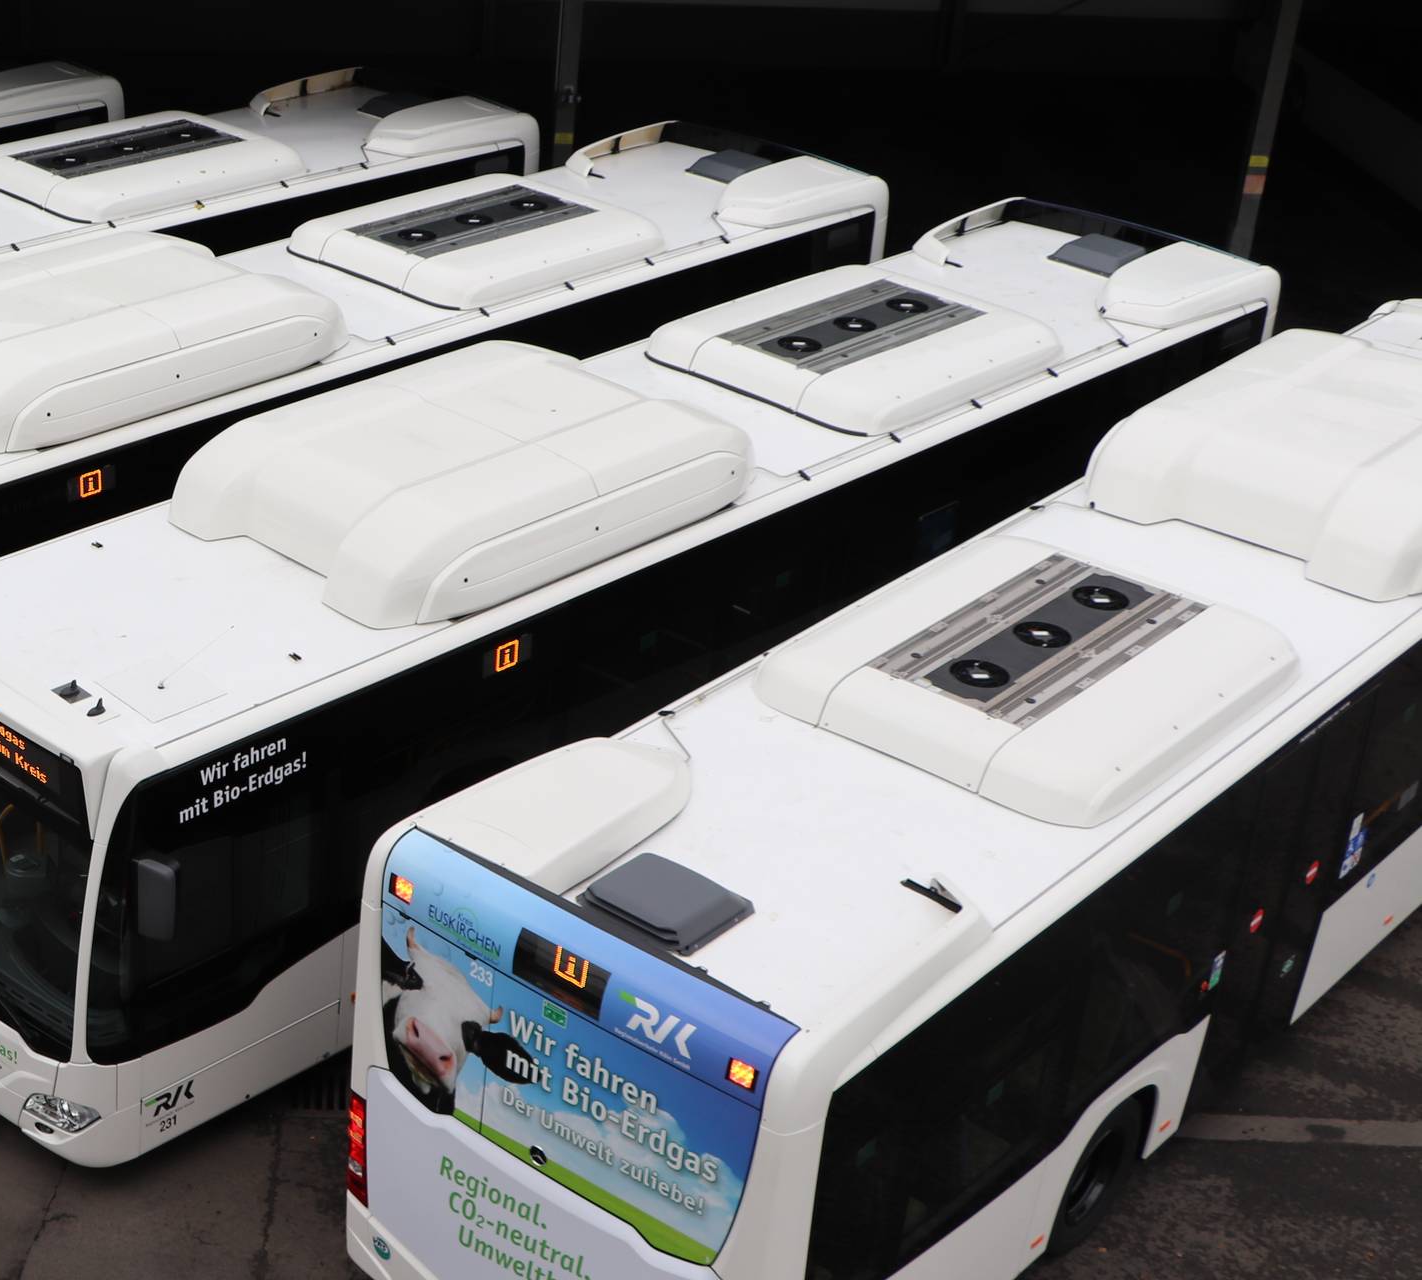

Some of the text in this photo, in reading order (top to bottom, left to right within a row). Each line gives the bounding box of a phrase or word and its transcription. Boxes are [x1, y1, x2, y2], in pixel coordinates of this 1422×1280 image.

[14, 752, 50, 784] Kreis
[179, 751, 307, 824] mit Bio-Erdgas!
[200, 738, 287, 786] Wir fahren
[428, 904, 501, 957] EUSKIRCHEN
[470, 961, 494, 987] 233
[509, 1010, 658, 1115] Wir fahren
[159, 1114, 177, 1133] 231
[506, 1049, 719, 1183] mit Bio-Erdgas
[502, 1087, 704, 1216] Der Umwelt zuliebe!
[440, 1155, 547, 1230] Regional.
